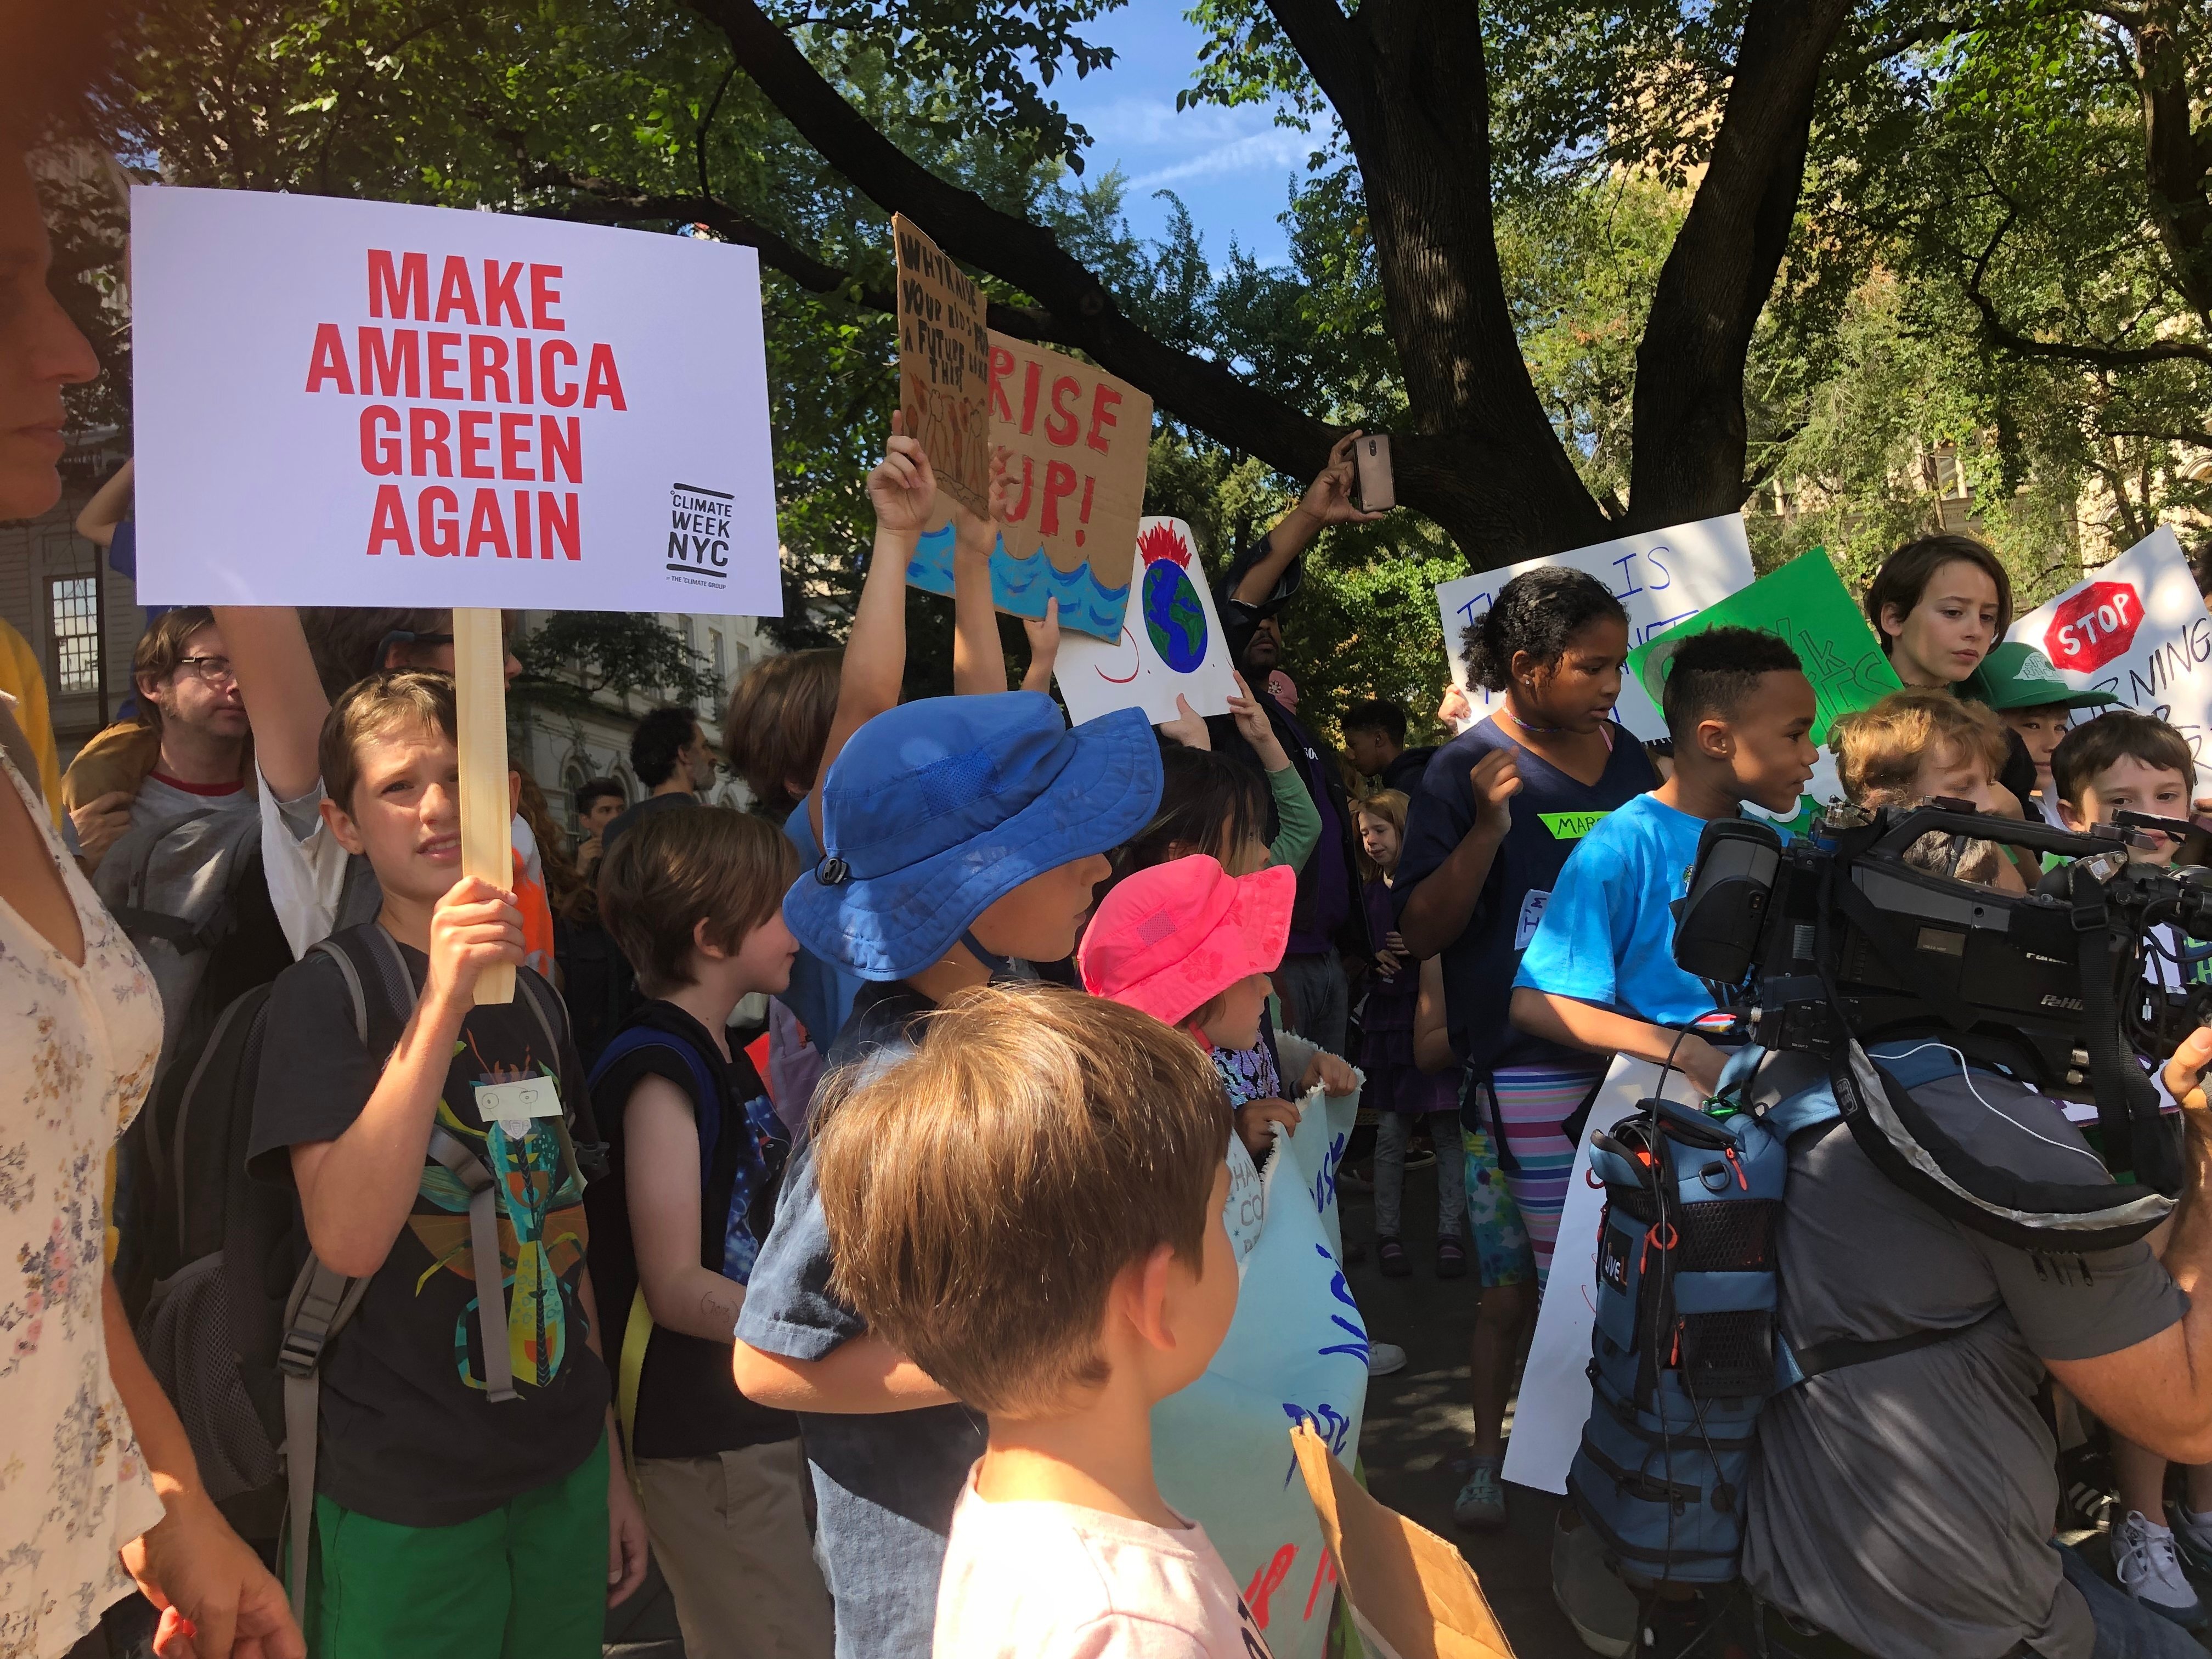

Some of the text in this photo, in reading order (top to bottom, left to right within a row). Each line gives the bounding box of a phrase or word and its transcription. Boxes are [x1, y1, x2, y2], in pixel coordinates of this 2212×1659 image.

[900, 232, 943, 286] WHY
[368, 249, 565, 331] MAKE
[904, 278, 941, 321] YOUR
[305, 323, 627, 411] AMERICA
[905, 327, 913, 352] A
[918, 319, 964, 370] FUTURE
[989, 345, 1122, 456] RISE
[360, 405, 583, 484] GREEN
[366, 484, 582, 561] AGAIN
[668, 531, 729, 567] NYC
[672, 510, 730, 538] WEEK
[1613, 546, 1670, 600] IS
[2058, 593, 2130, 656] STOP
[1557, 816, 1601, 835] MAR
